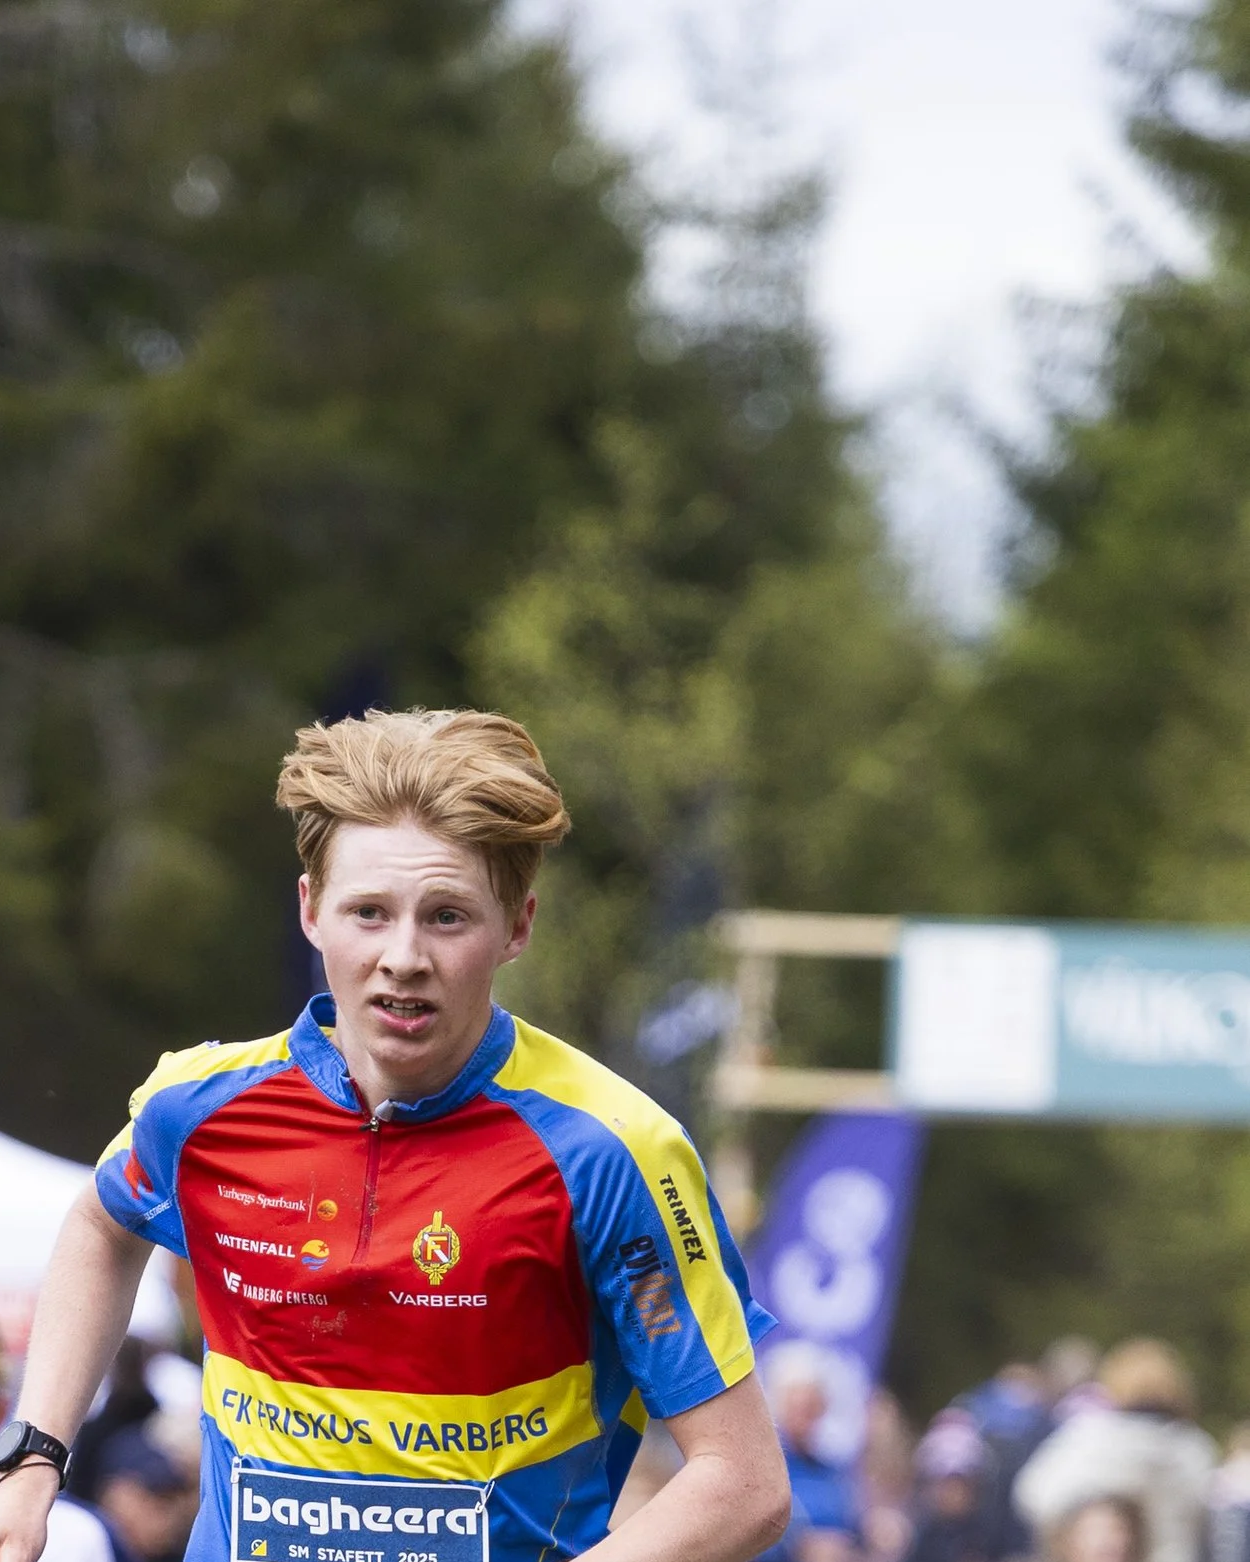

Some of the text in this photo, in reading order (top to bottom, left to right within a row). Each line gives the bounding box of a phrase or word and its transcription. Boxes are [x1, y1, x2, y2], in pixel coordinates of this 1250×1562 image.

[217, 1184, 306, 1212] Varbergs Sparbank
[659, 1174, 707, 1264] TRIMTEX
[215, 1232, 295, 1258] VATTENFALL
[242, 1283, 328, 1306] VARBERG ENERGI
[388, 1290, 488, 1307] VARBERG
[222, 1387, 549, 1452] FK FRISKUS VARBERG
[243, 1487, 479, 1536] bagheera
[288, 1544, 310, 1560] SM
